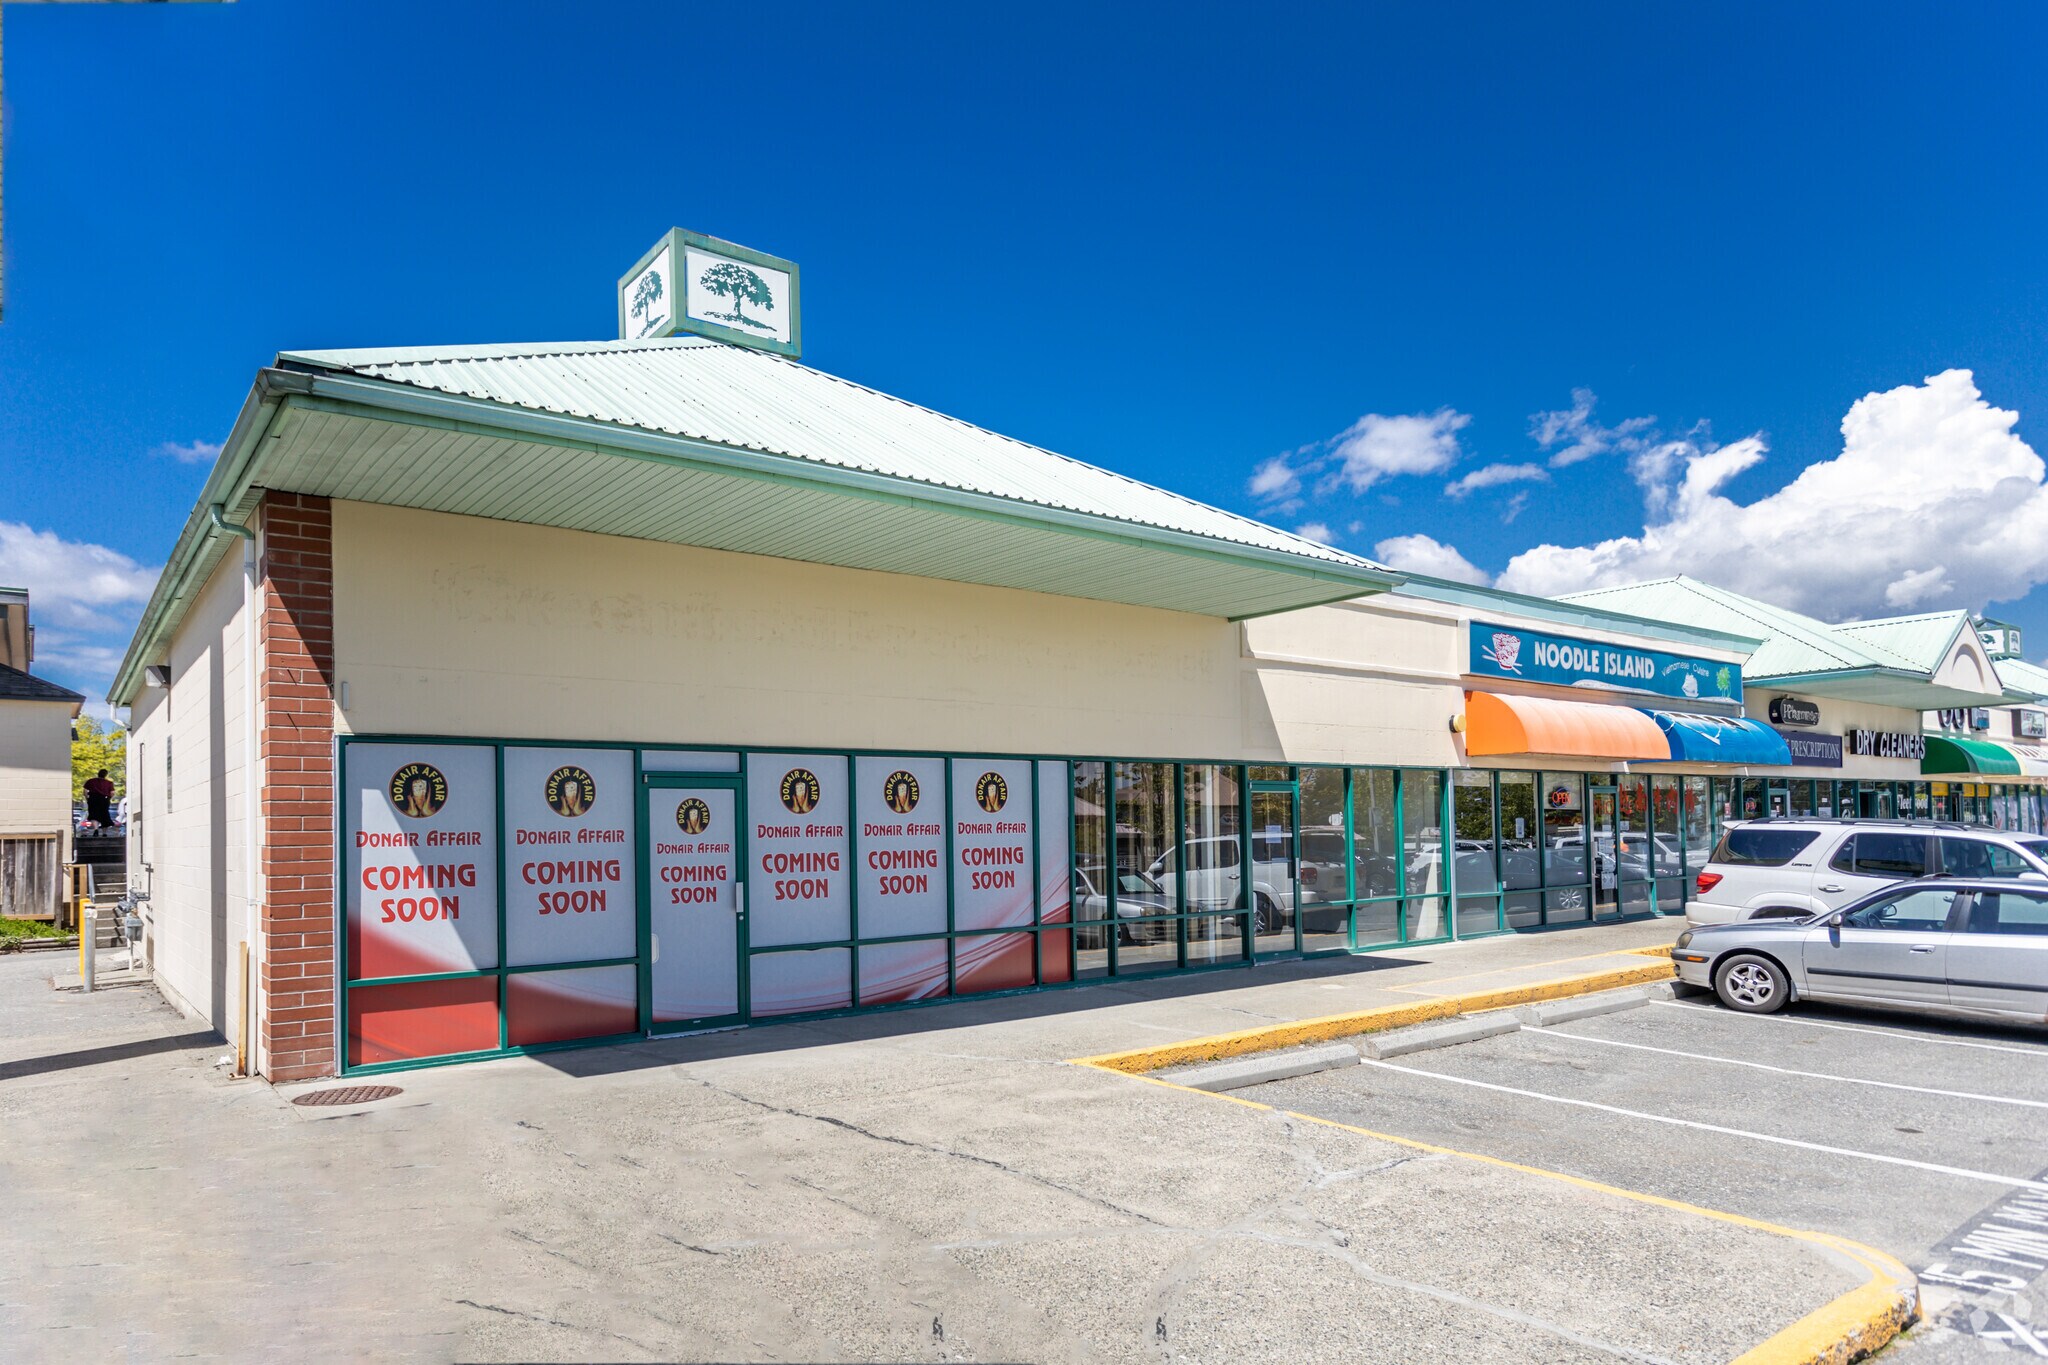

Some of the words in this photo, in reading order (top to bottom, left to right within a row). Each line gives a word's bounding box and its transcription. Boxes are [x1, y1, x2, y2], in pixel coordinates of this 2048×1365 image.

[1535, 641, 1600, 673] NOODLE
[1605, 652, 1654, 680] ISLAND
[1662, 662, 1690, 677] Vietnamese
[1693, 664, 1710, 677] Cuisine
[1791, 740, 1840, 760] PRESCRIPTIONS
[1856, 730, 1876, 756] DRY
[1880, 732, 1926, 760] CLEANERS
[394, 765, 418, 802] DONAIR
[422, 766, 445, 801] AFFAIR
[548, 768, 570, 802] DONAIR
[573, 769, 593, 802] AFFAIR
[782, 770, 800, 801] DONAIR
[802, 771, 818, 800] AFFAIR
[886, 772, 902, 801] DONAIR
[904, 774, 918, 801] AFFAIR
[978, 774, 991, 801] DONAIR
[993, 774, 1006, 801] AFFAIR
[1552, 792, 1572, 805] OPEN
[678, 800, 693, 824] DONAIR
[696, 801, 709, 824] AFFAIR
[762, 852, 840, 874] COMING
[868, 850, 938, 870] COMING
[962, 846, 1024, 866] COMING
[362, 863, 476, 890] COMING
[522, 860, 621, 885] COMING
[660, 865, 727, 883] COMING
[972, 870, 1015, 890] SOON
[671, 887, 717, 904] SOON
[774, 878, 829, 900] SOON
[880, 875, 928, 895] SOON
[381, 896, 459, 923] SOON
[538, 890, 606, 915] SOON
